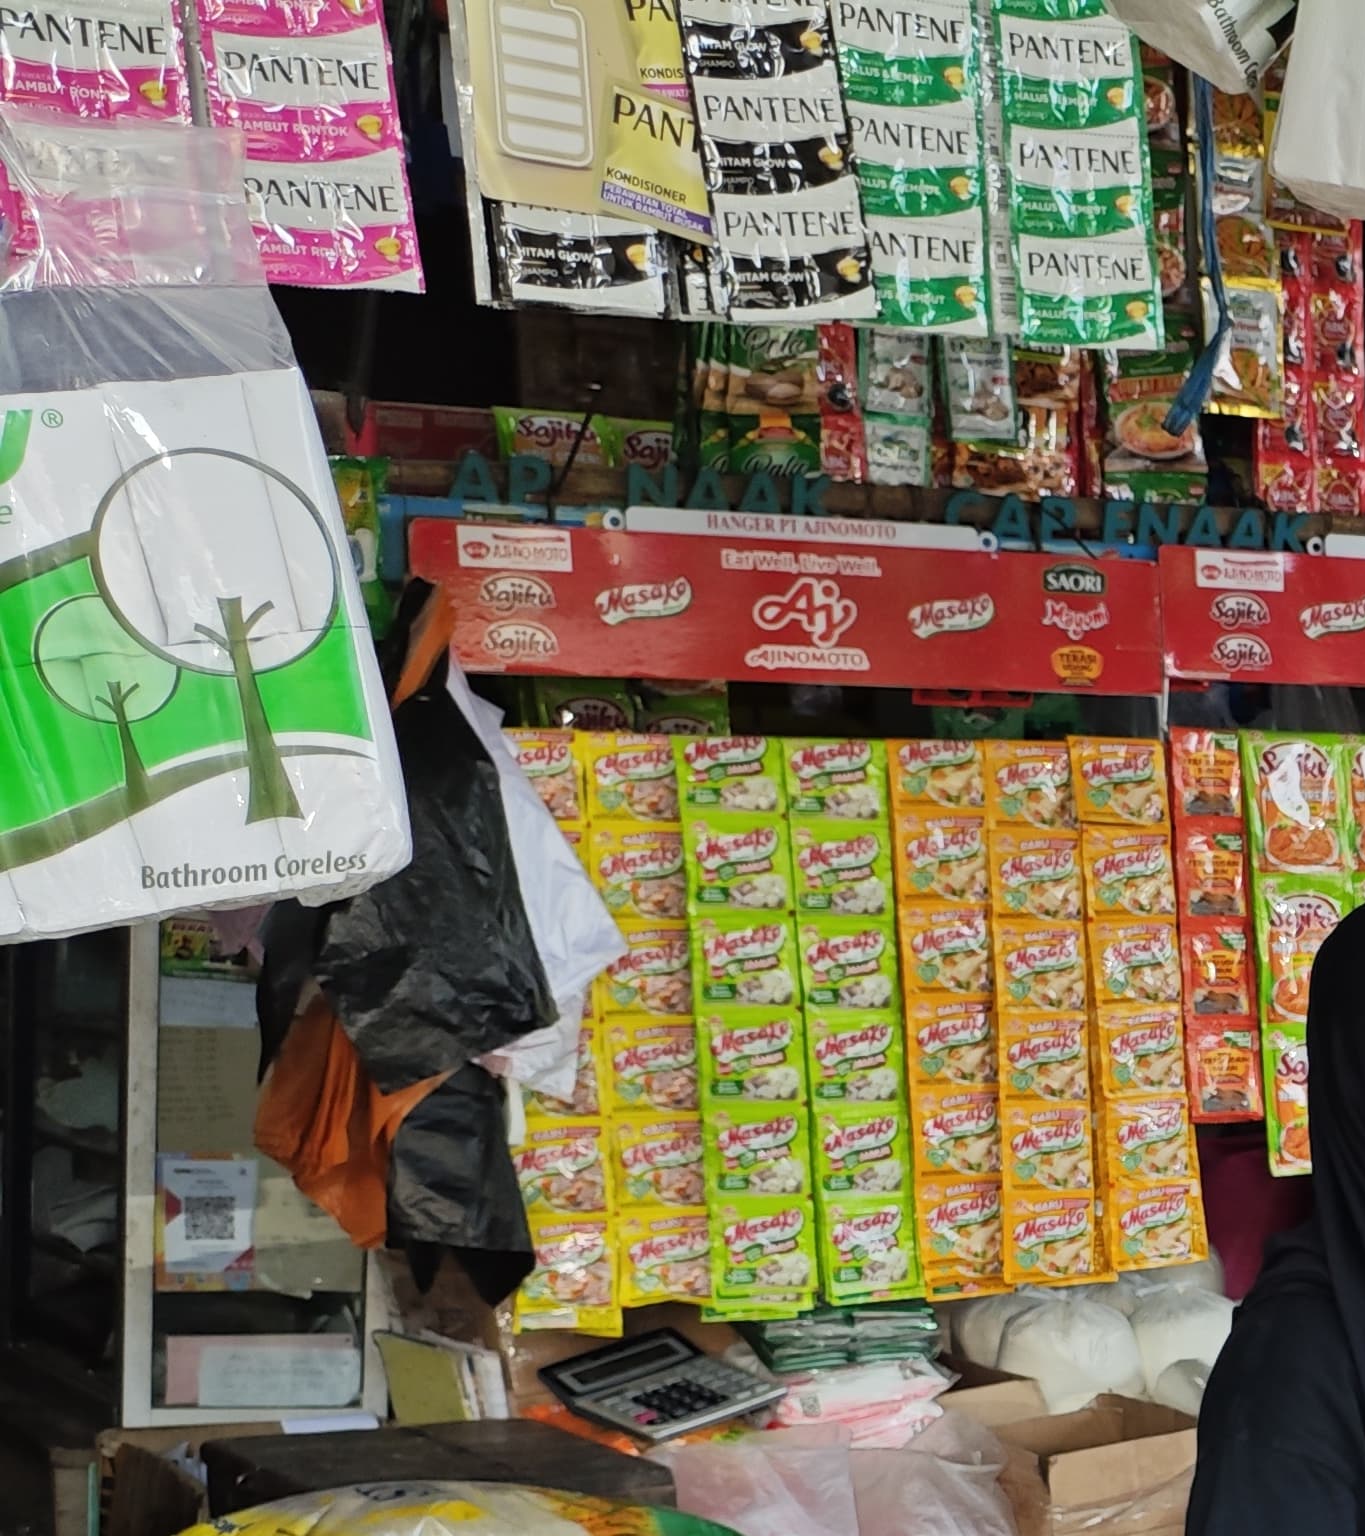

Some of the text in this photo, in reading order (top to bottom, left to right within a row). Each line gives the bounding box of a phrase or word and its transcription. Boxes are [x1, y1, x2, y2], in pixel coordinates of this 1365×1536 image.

[840, 2, 964, 44] PANTENE
[1009, 32, 1126, 67] PANTENE
[224, 50, 380, 91] PANTENE
[612, 93, 699, 153] PANT
[704, 95, 838, 123] PANTENE
[849, 115, 970, 155] PANTENE
[1020, 142, 1136, 175] PANTENE
[245, 176, 399, 214] PANTENE
[603, 193, 637, 210] UNTUK
[604, 184, 688, 219] PERAWATAN TOTAL
[606, 167, 687, 204] KONDISIONER
[724, 210, 855, 238] PANTENE
[872, 231, 975, 264] ANTENE
[1028, 252, 1145, 282] PANTENE
[707, 515, 897, 540] HANGER PT AJINOMOTO
[481, 577, 552, 611] Sajiku
[602, 578, 688, 614] Masako
[1046, 571, 1101, 592] SAORI
[912, 597, 990, 635] Masako
[1211, 597, 1268, 629] Sajiku
[486, 626, 556, 659] Sajiku
[749, 650, 864, 667] AJINOMOTO
[1213, 639, 1271, 671] Sajiku
[700, 828, 773, 863] Masako
[141, 851, 367, 889] Bathroom Coreless
[1002, 851, 1073, 881] Masako
[705, 924, 781, 960] Masako
[711, 1021, 789, 1056] Masako
[816, 1024, 891, 1058] Masako
[1009, 1031, 1079, 1061] Masako
[719, 1117, 796, 1152] Masako
[1012, 1119, 1083, 1152] Masako
[929, 1190, 998, 1226] Masako
[1121, 1194, 1183, 1230] Masako
[726, 1210, 801, 1247] Masako
[1014, 1209, 1085, 1243] Masako
